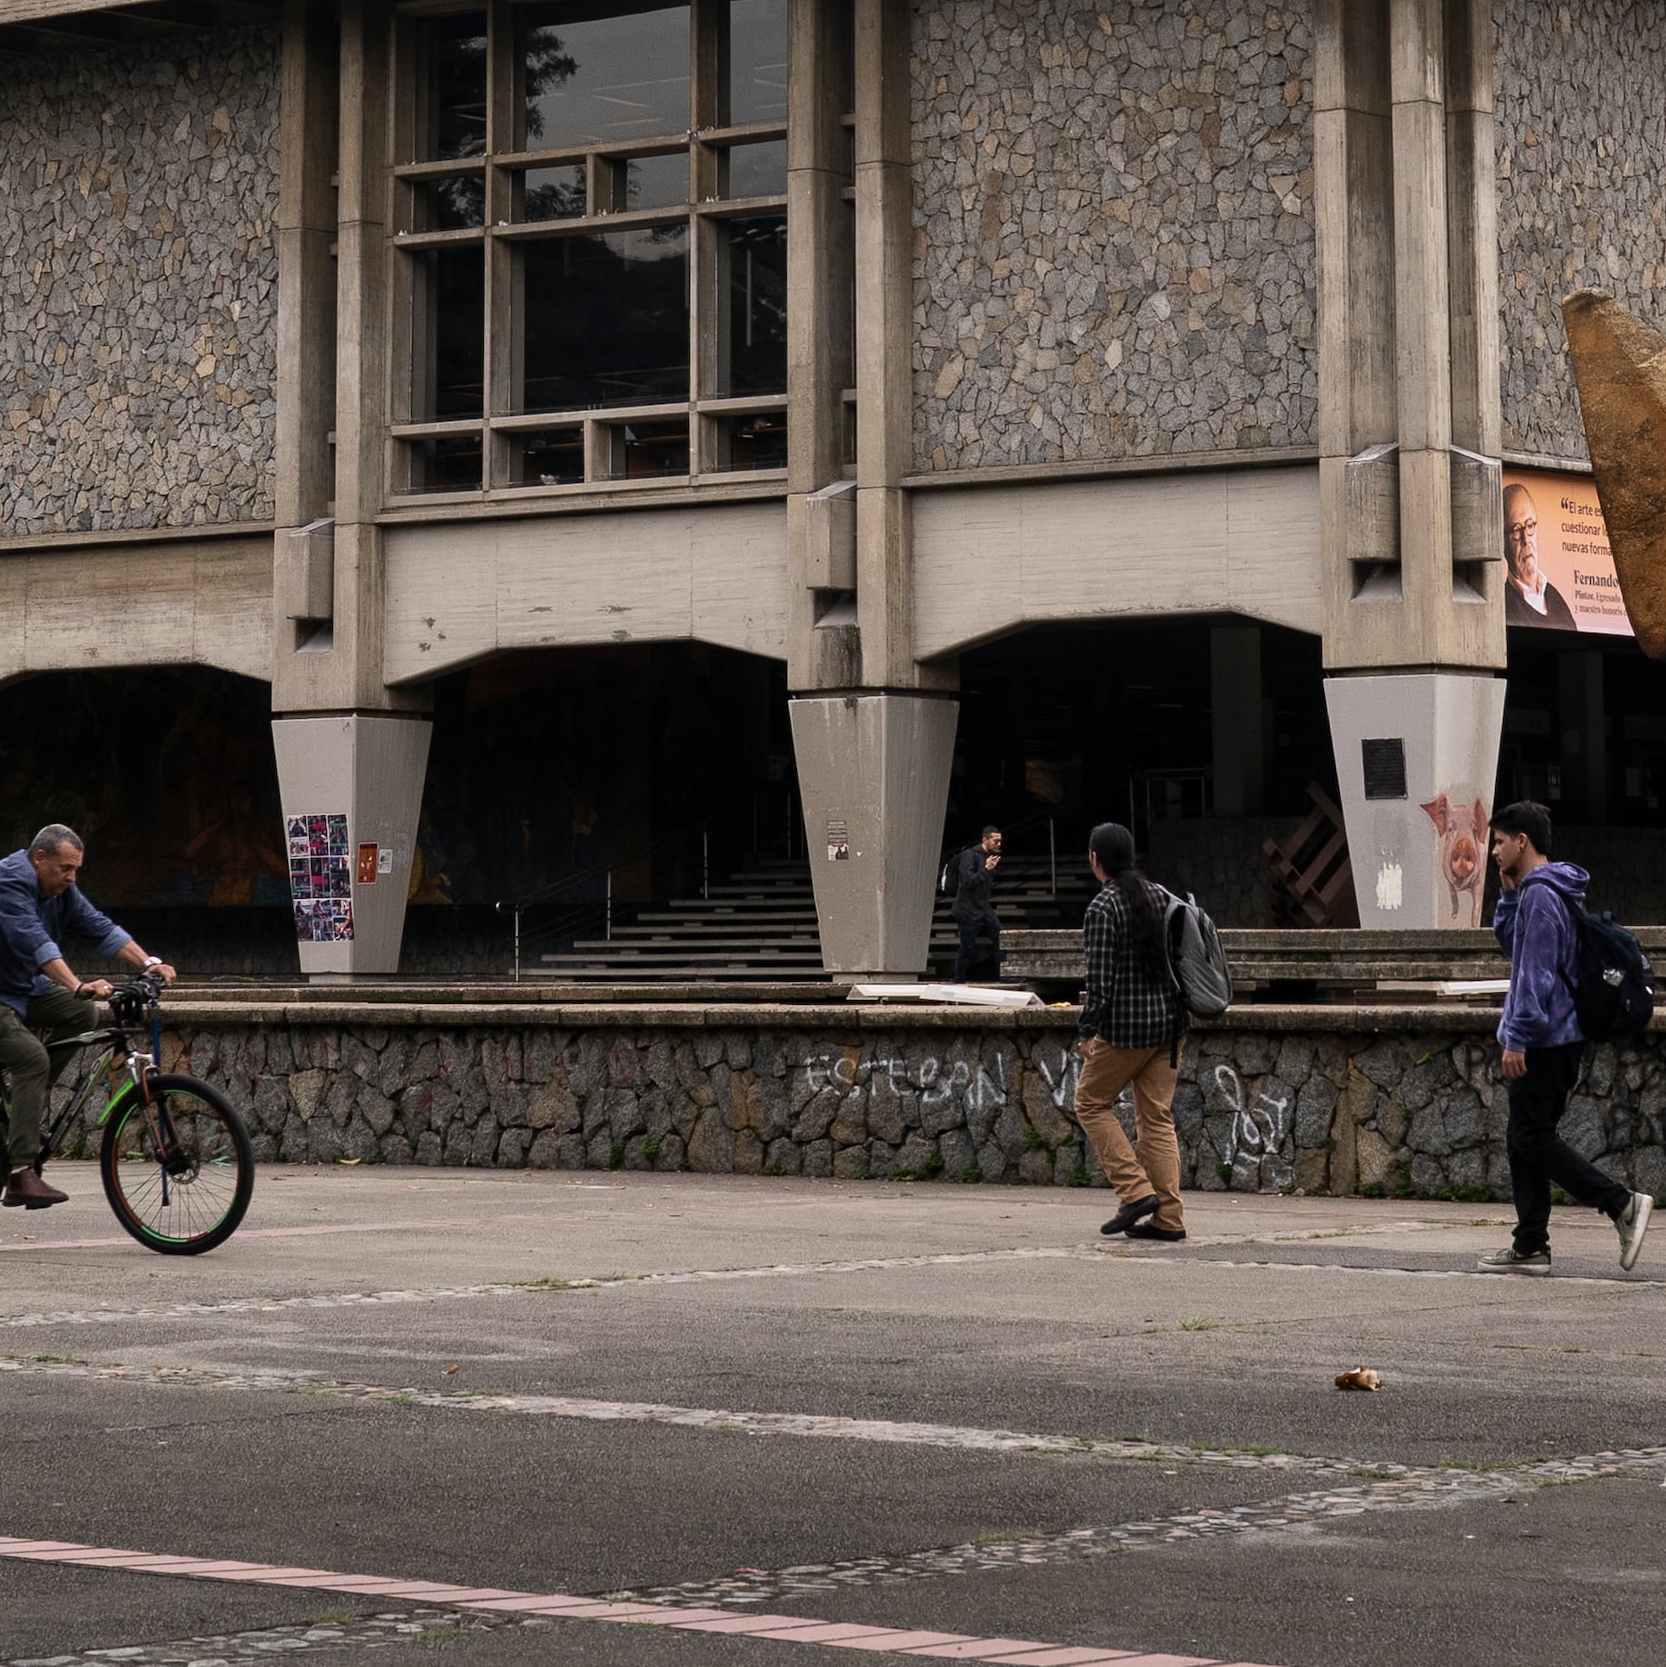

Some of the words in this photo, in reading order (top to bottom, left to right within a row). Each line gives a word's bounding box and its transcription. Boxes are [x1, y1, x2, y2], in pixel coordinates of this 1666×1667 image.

[1577, 504, 1593, 516] arte
[1561, 521, 1601, 537] cuestionar
[1562, 542, 1589, 554] nuevas
[1573, 570, 1619, 588] Fernando
